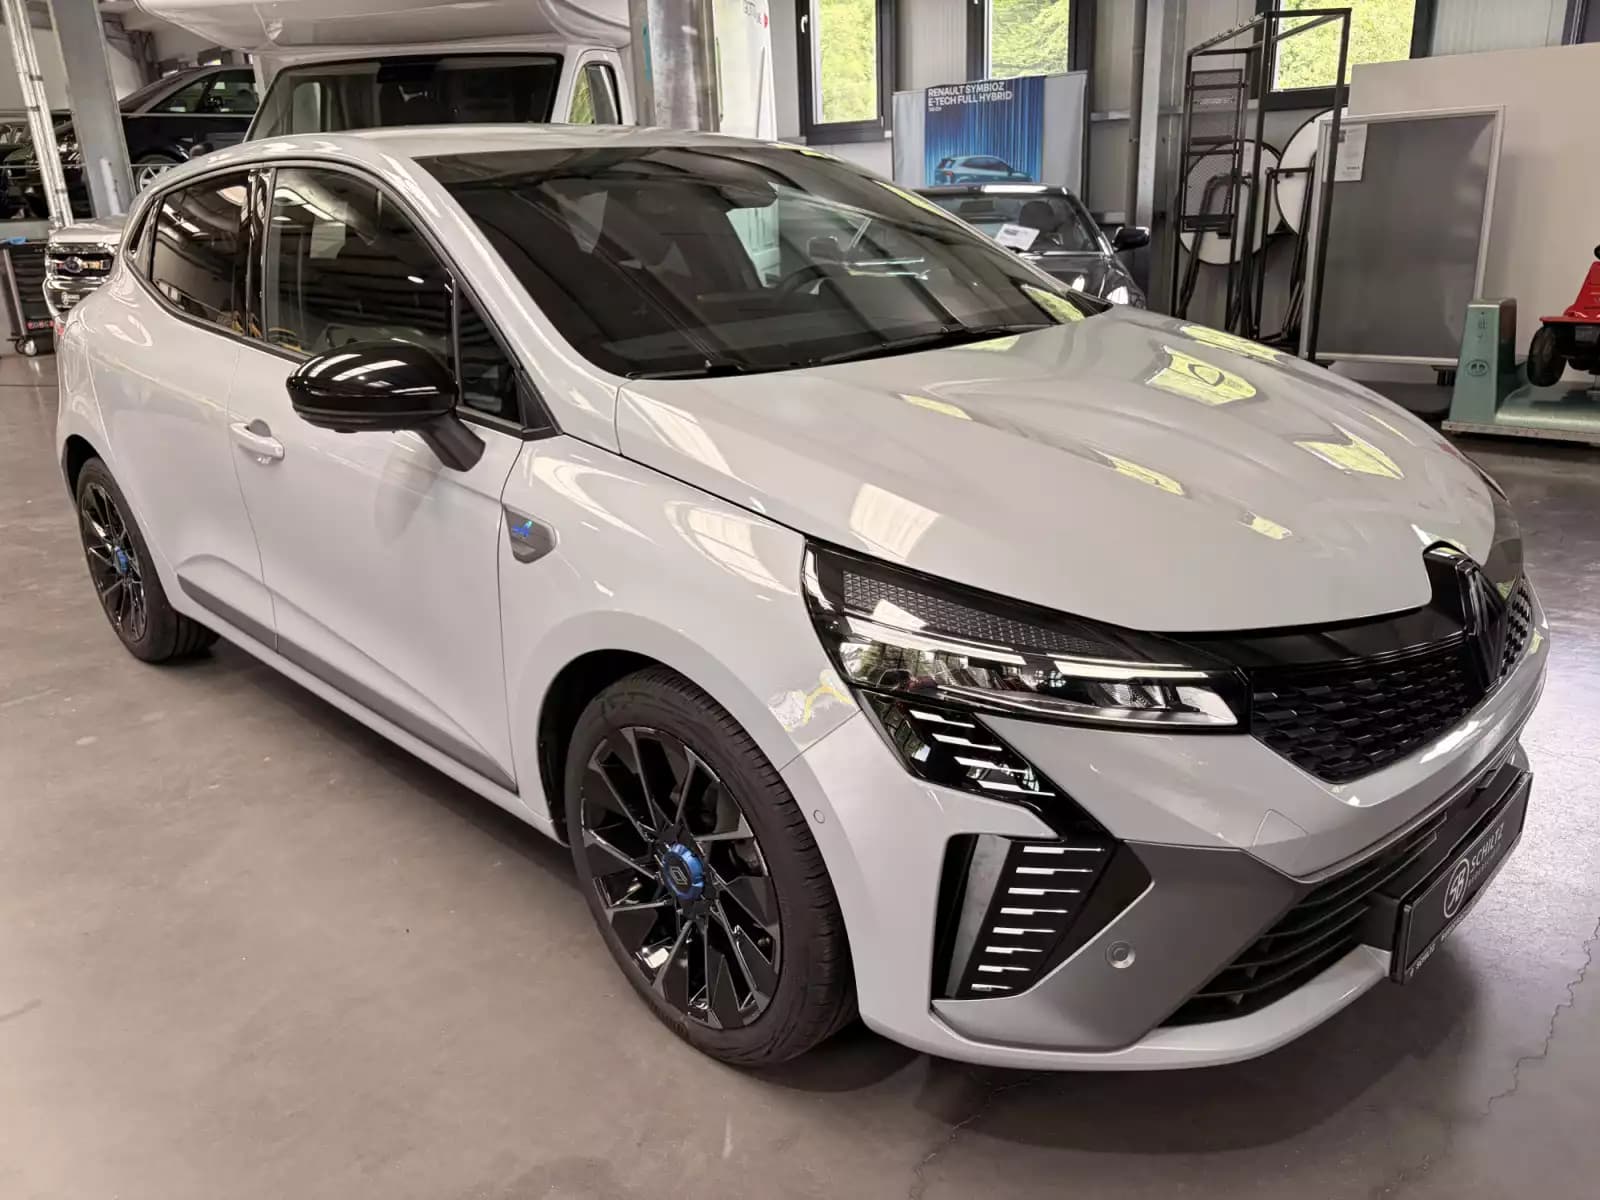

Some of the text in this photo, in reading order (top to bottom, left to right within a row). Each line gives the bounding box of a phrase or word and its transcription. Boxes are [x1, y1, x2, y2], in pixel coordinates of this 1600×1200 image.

[928, 82, 1004, 97] RENAULT SYMBIOZ
[928, 91, 1013, 106] E-TECH FULL HYBRID
